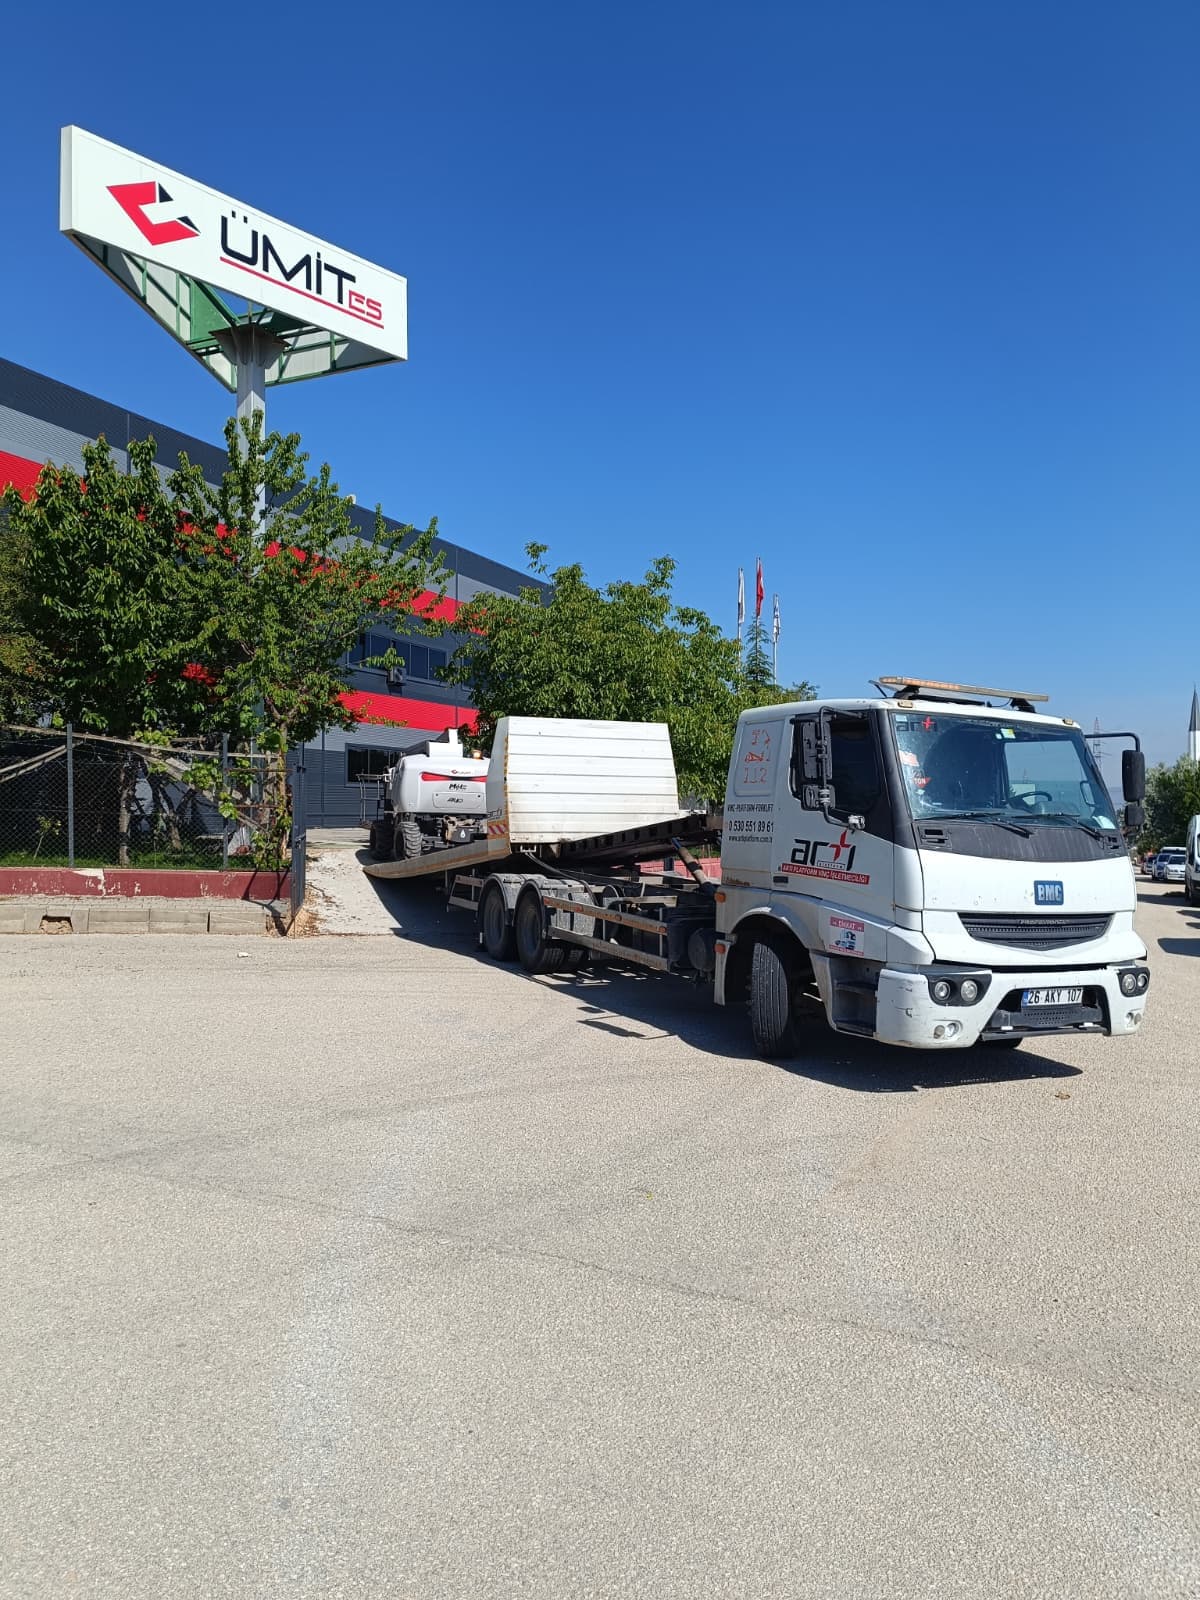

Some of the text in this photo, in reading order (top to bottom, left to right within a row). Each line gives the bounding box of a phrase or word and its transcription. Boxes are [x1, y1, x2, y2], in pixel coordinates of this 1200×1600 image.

[728, 820, 774, 832] 0 530 551 89 61
[793, 866, 818, 877] PLATFORM
[1037, 884, 1062, 902] BMC
[1028, 988, 1082, 1004] 26 AKY 107
